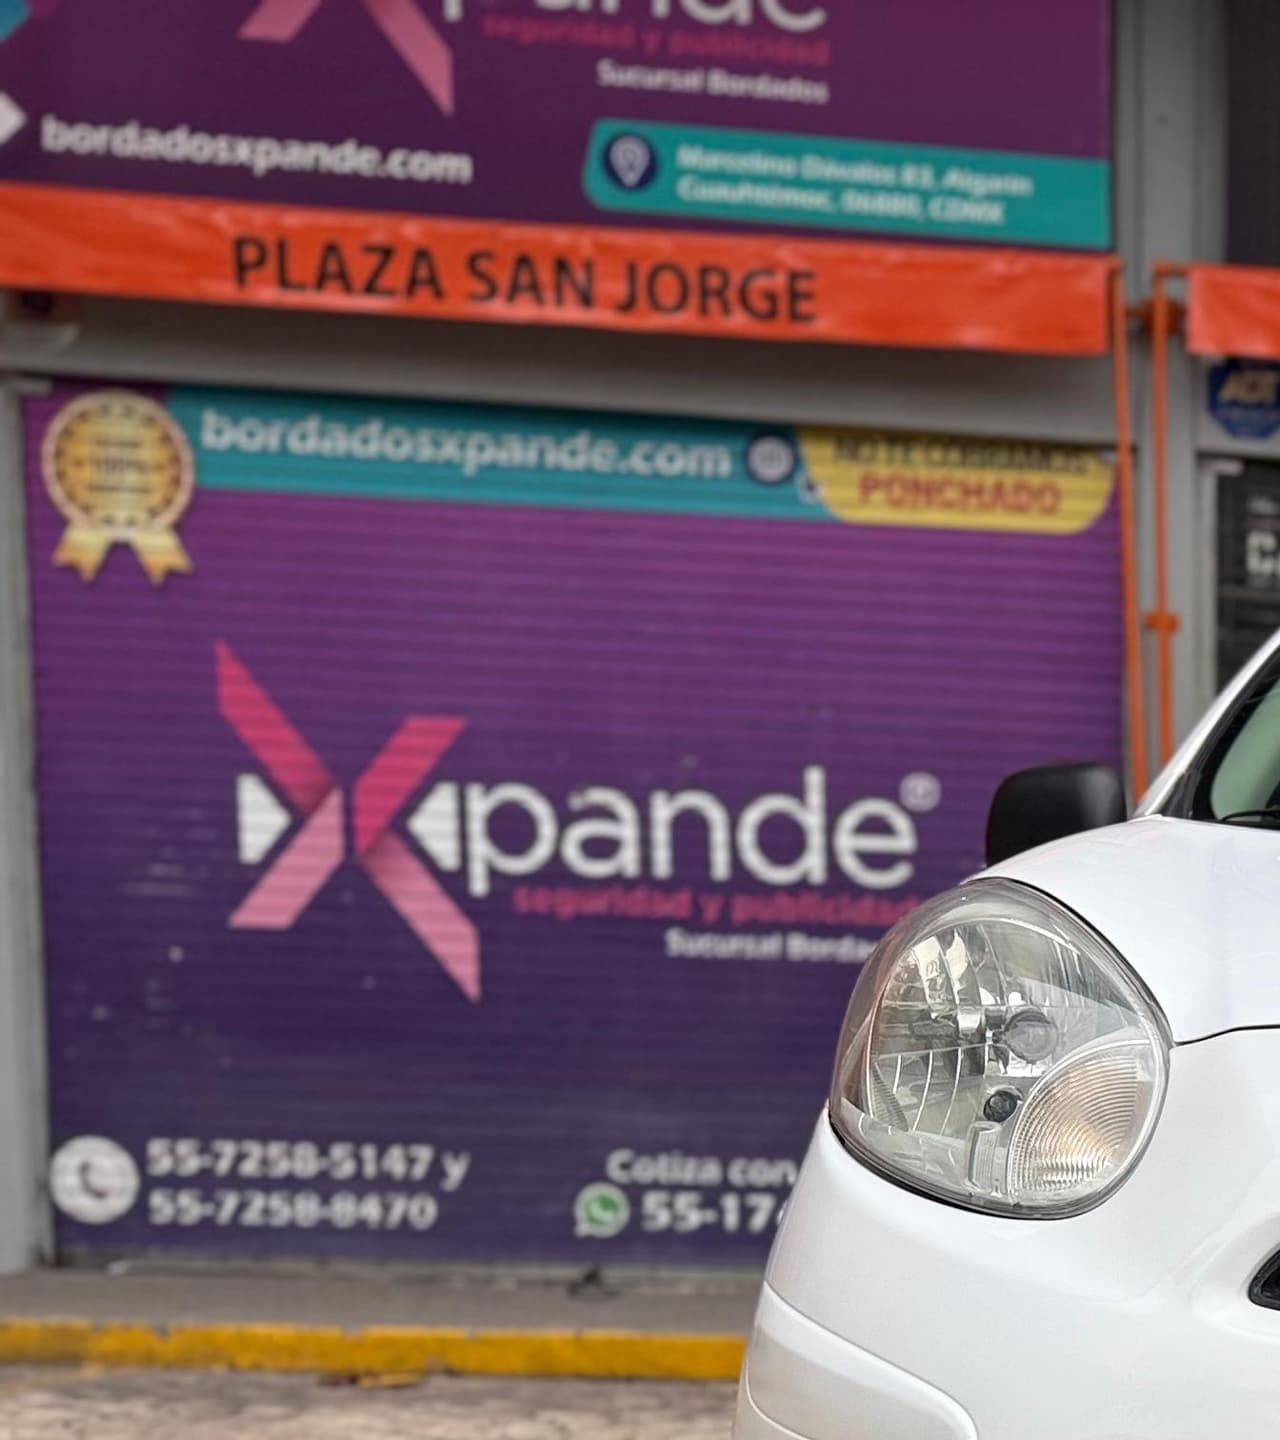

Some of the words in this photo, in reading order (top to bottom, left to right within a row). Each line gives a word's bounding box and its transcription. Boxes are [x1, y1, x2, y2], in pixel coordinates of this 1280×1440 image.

[597, 58, 704, 93] Sucursal
[707, 66, 830, 104] Bordados
[40, 113, 474, 185] bordadosxpande.com
[232, 234, 445, 301] PLAZA
[466, 249, 598, 312] SAN
[614, 259, 818, 323] JORGE
[201, 408, 732, 478] bordadosxpande.com
[858, 470, 1062, 516] PONCHADO
[663, 926, 783, 960] Sucursal
[787, 934, 879, 965] Borda
[147, 1138, 435, 1181] 55-7258-5147
[440, 1152, 471, 1192] y
[606, 1148, 723, 1185] Cotiza
[727, 1157, 798, 1188] con
